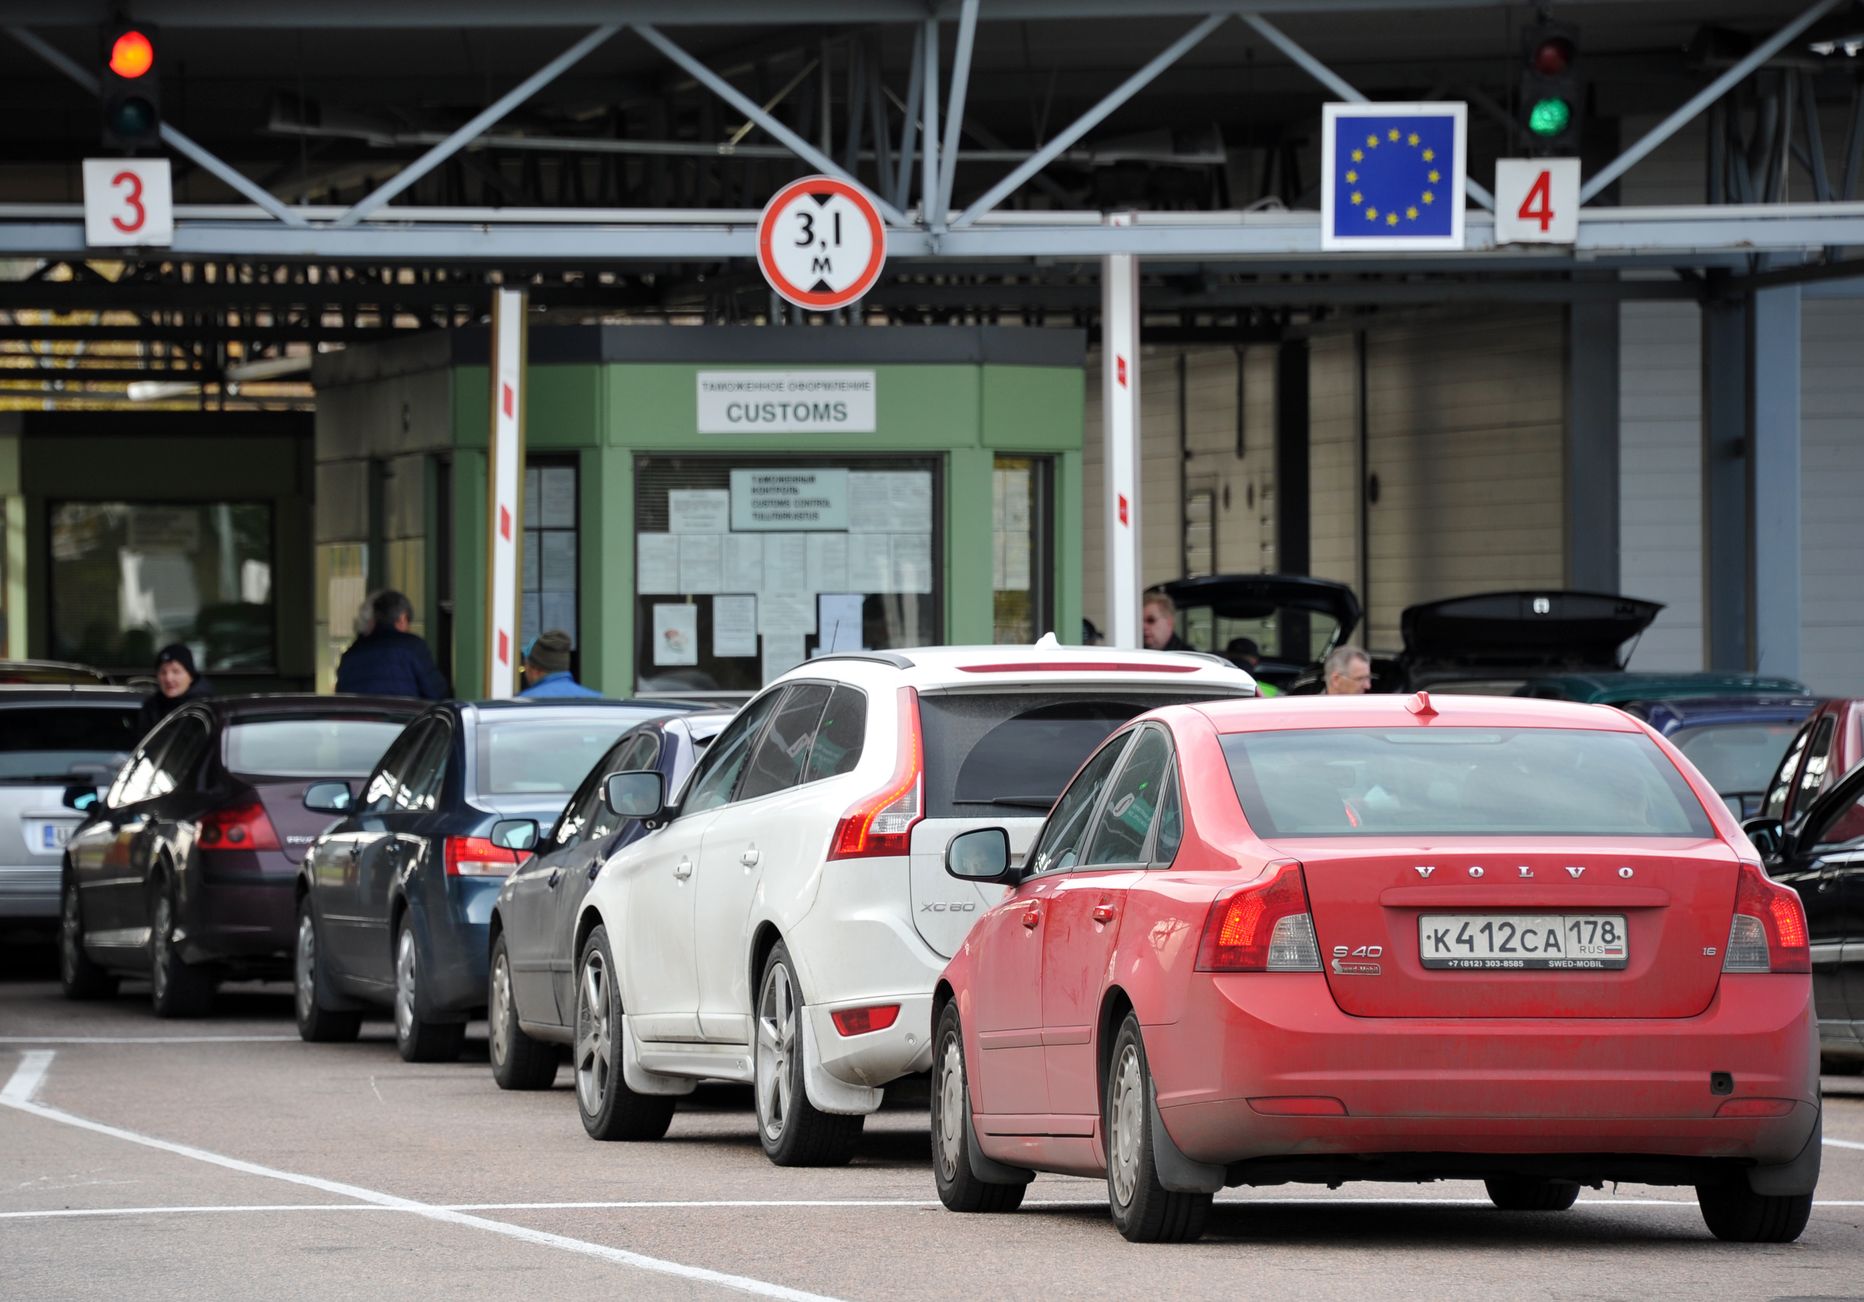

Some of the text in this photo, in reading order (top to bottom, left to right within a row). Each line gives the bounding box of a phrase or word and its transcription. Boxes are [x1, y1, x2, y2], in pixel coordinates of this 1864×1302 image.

[111, 171, 145, 232] 3
[1517, 169, 1554, 232] 4
[702, 381, 871, 392] ТАМОЖЕННОЕ ОФОРМЛЕНИЕ
[726, 402, 848, 423] CUSTOMS
[1415, 866, 1634, 879] VOLVO
[1569, 920, 1616, 945] 178
[1351, 945, 1383, 958] 40
[1579, 945, 1604, 955] RUS
[1460, 960, 1483, 968] (812)
[1548, 960, 1604, 968] SWED-MOBIL
